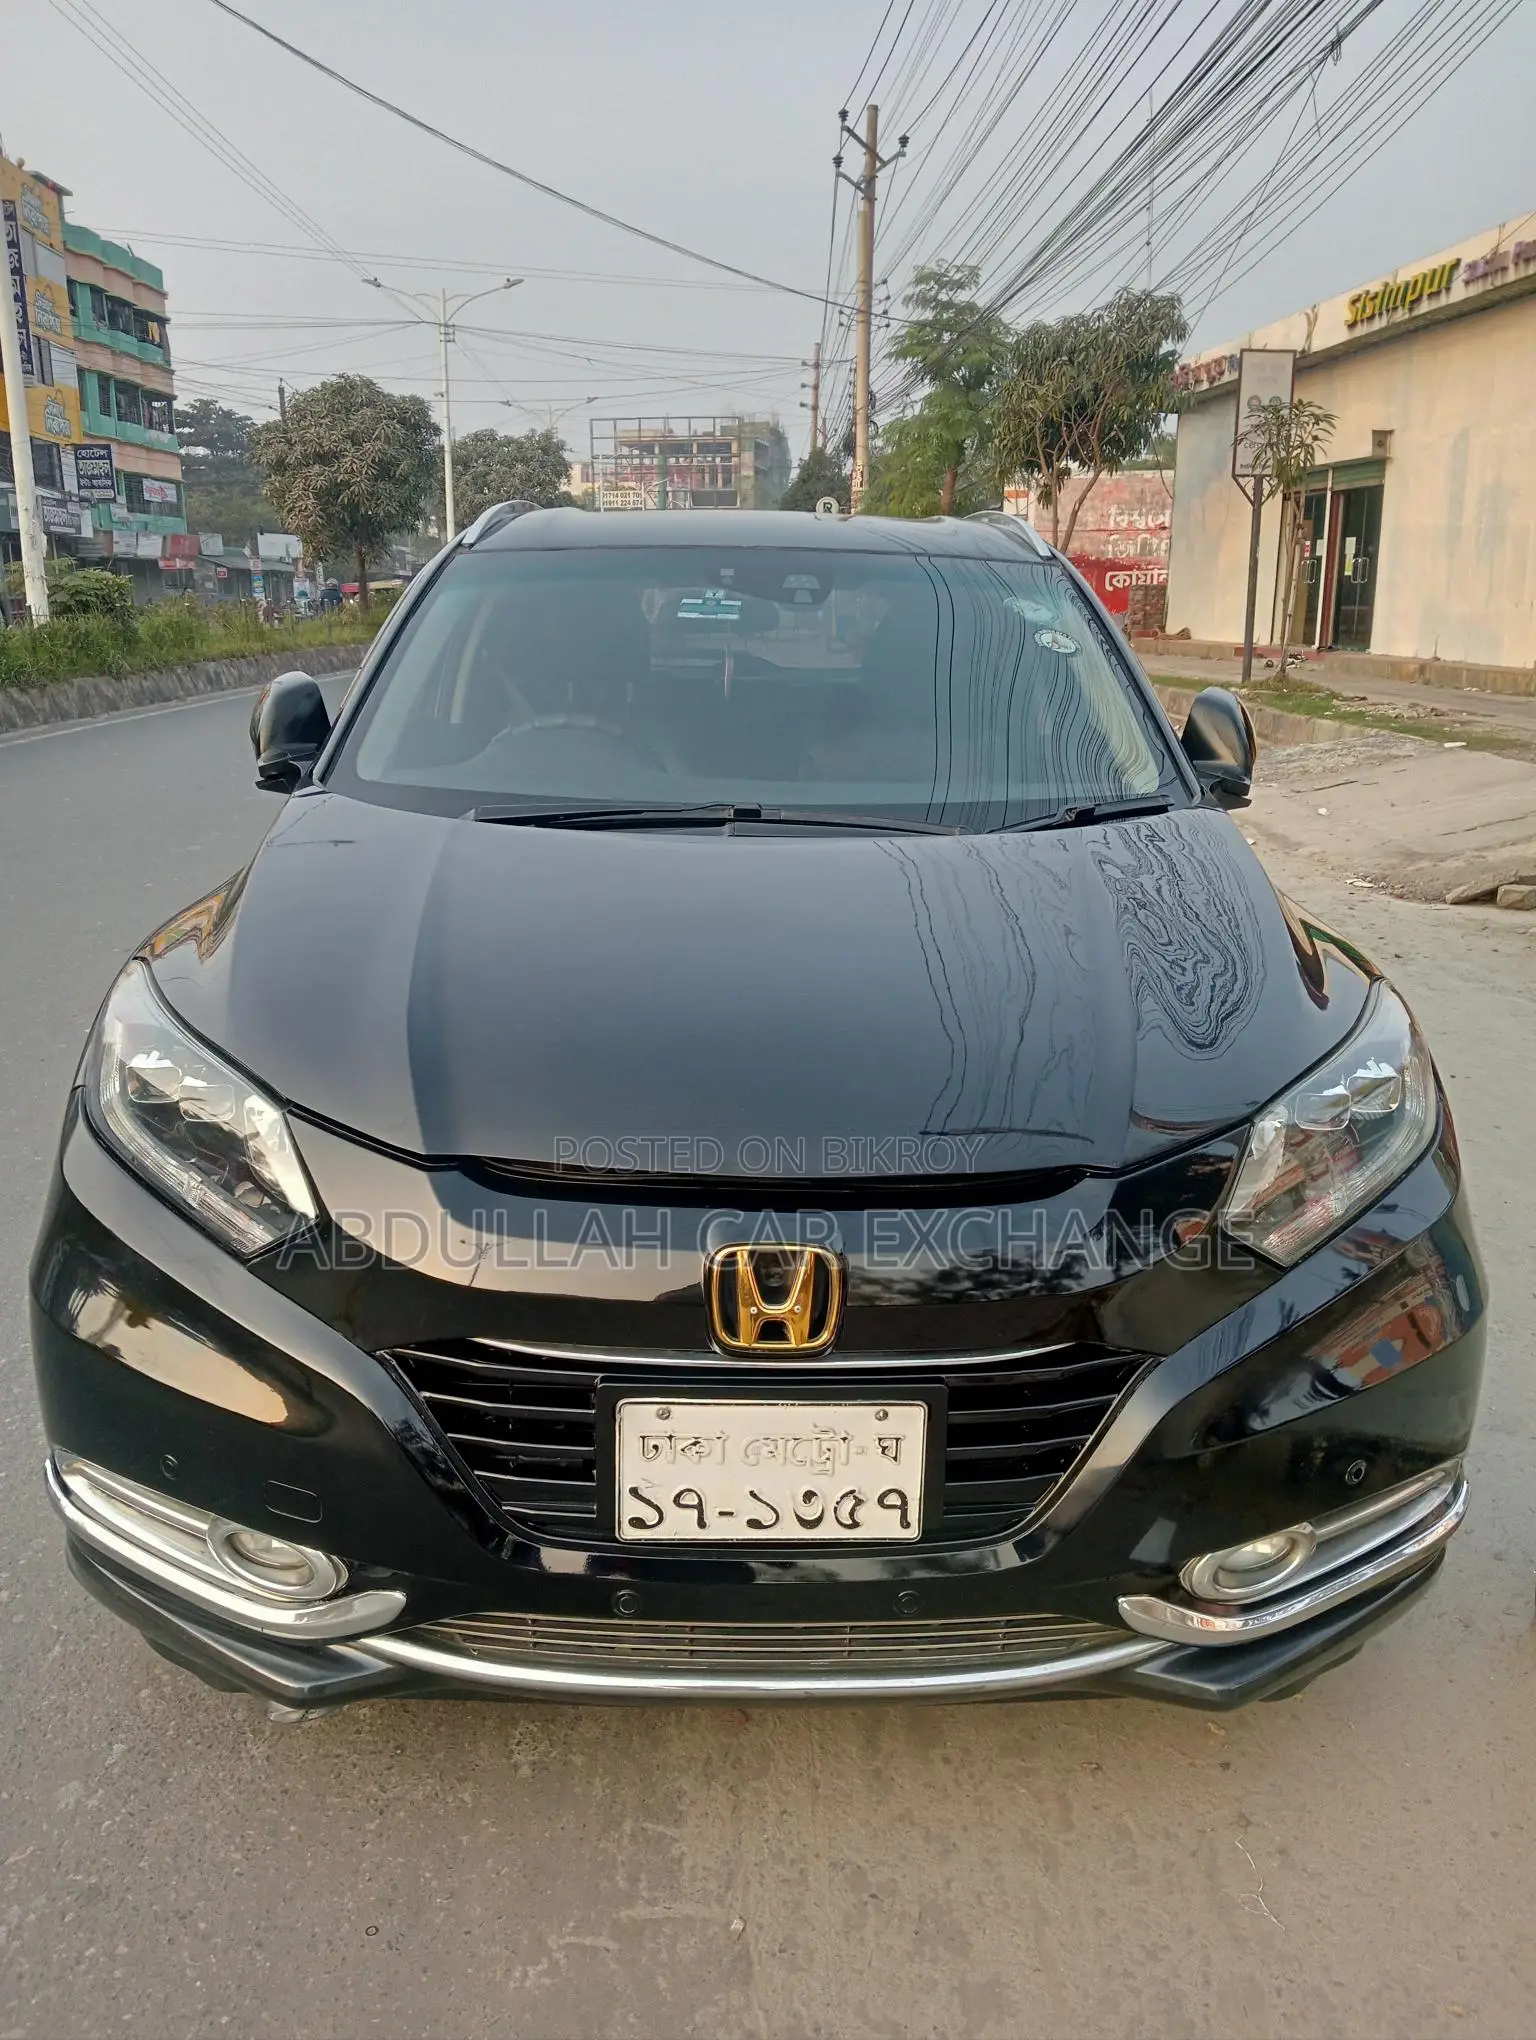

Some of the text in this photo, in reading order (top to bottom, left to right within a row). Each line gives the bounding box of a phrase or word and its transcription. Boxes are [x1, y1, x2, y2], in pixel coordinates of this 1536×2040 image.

[1344, 258, 1460, 326] Sisimpur
[823, 502, 832, 513] R
[638, 1430, 728, 1465] ঢাকা
[627, 1485, 912, 1530] ১৭-১৩৫৭
